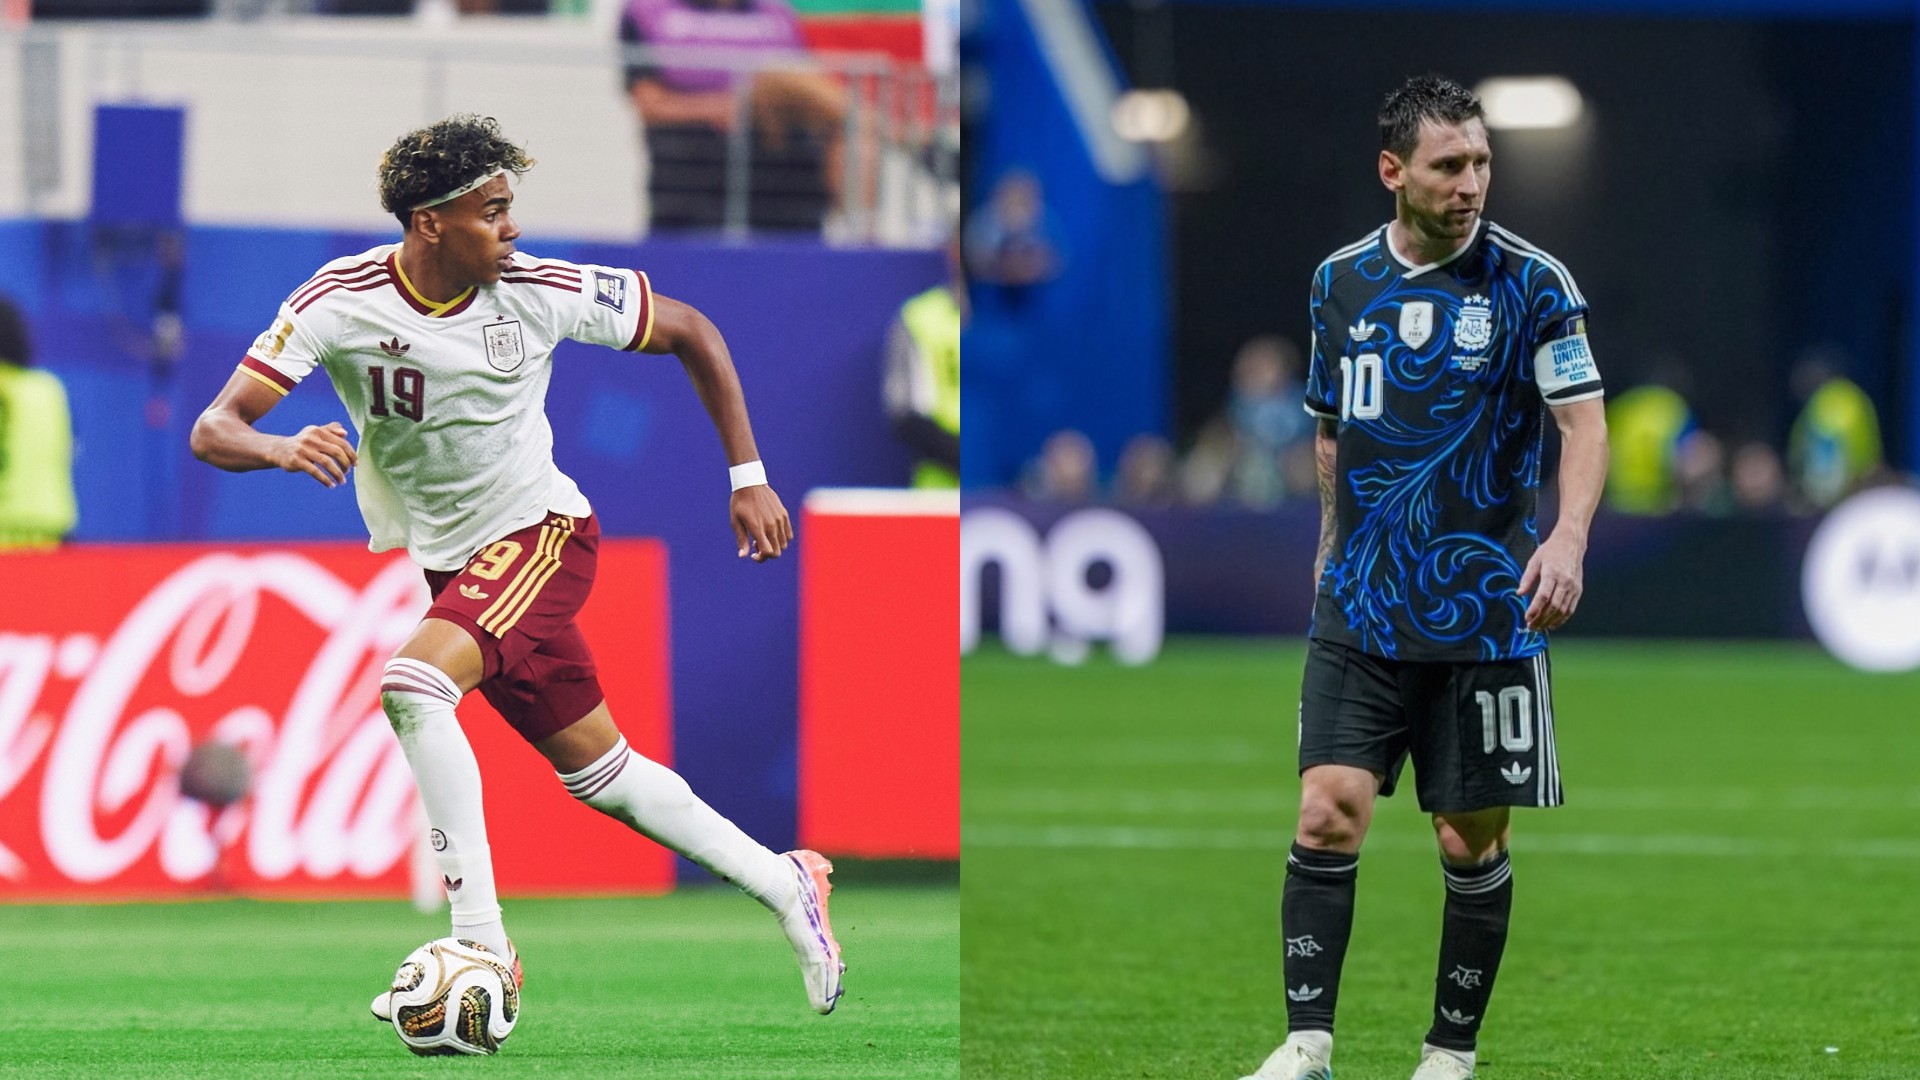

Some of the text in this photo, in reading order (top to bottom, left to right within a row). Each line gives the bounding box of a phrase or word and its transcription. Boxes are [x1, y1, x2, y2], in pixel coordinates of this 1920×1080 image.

[1554, 346, 1589, 365] UNITES
[368, 366, 426, 423] 19
[1340, 353, 1384, 422] 10
[460, 540, 523, 580] 9
[1475, 686, 1533, 754] 10
[1287, 935, 1323, 957] AFA
[1448, 964, 1482, 989] AFA
